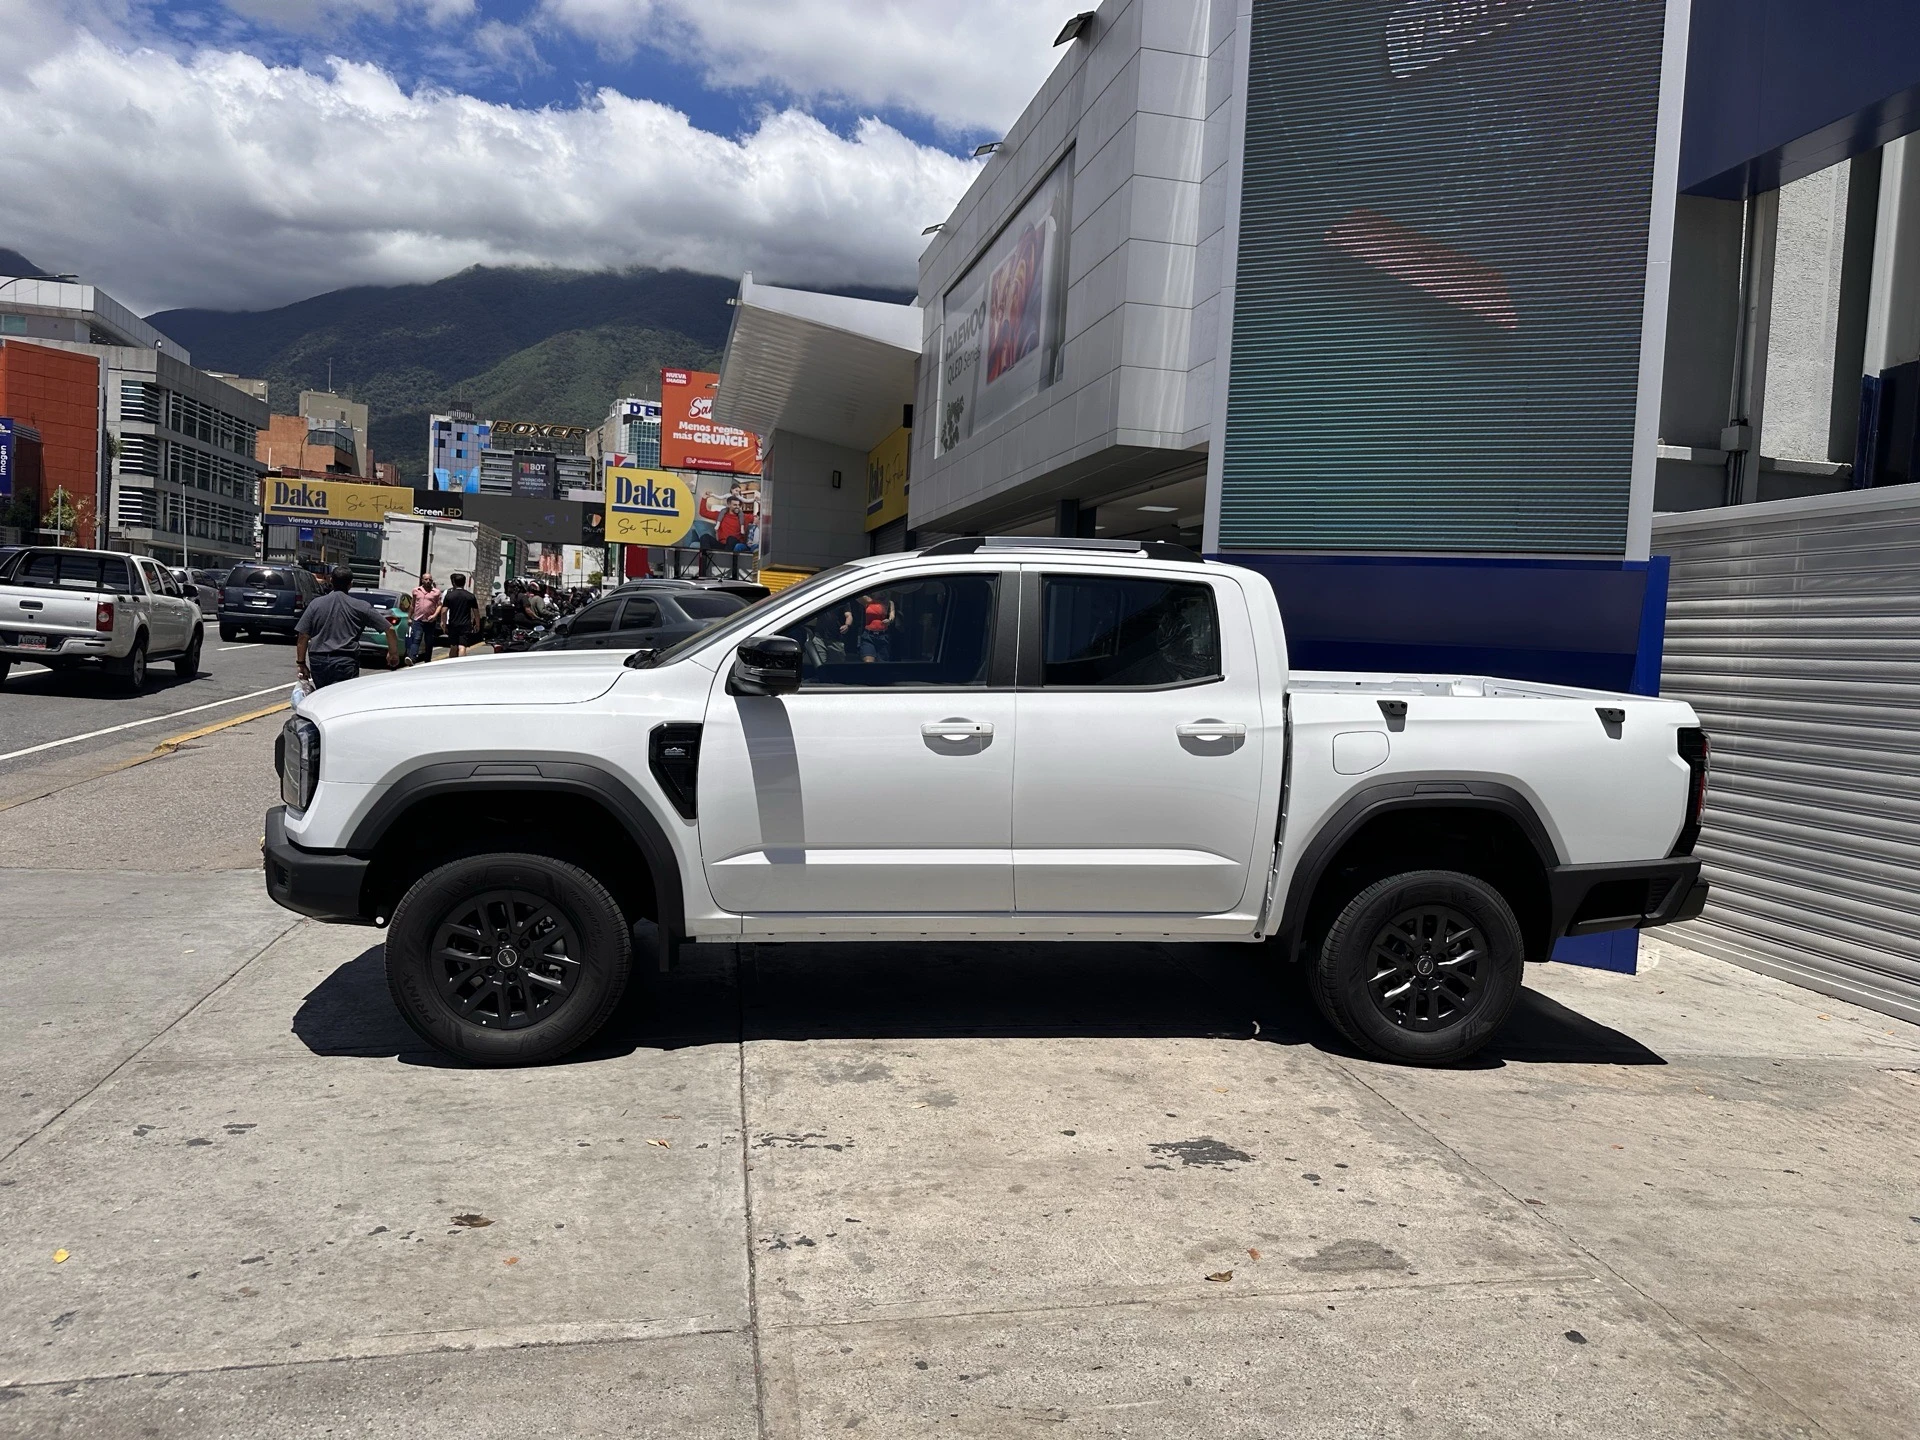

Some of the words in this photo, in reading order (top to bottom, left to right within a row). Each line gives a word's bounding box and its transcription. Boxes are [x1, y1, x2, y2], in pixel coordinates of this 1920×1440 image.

[945, 300, 986, 361] DAEWOO
[947, 355, 963, 386] QLED
[629, 402, 662, 416] DE
[689, 397, 712, 418] Sa
[490, 420, 587, 440] BOXER
[678, 421, 711, 431] Menos
[672, 431, 692, 440] más
[693, 432, 749, 447] CRUNCH
[274, 482, 327, 508] Daka
[615, 476, 676, 508] Daka
[371, 495, 404, 512] Feliz
[287, 516, 314, 524] Viernes
[319, 518, 344, 527] Sábado
[640, 519, 672, 536] Feliz
